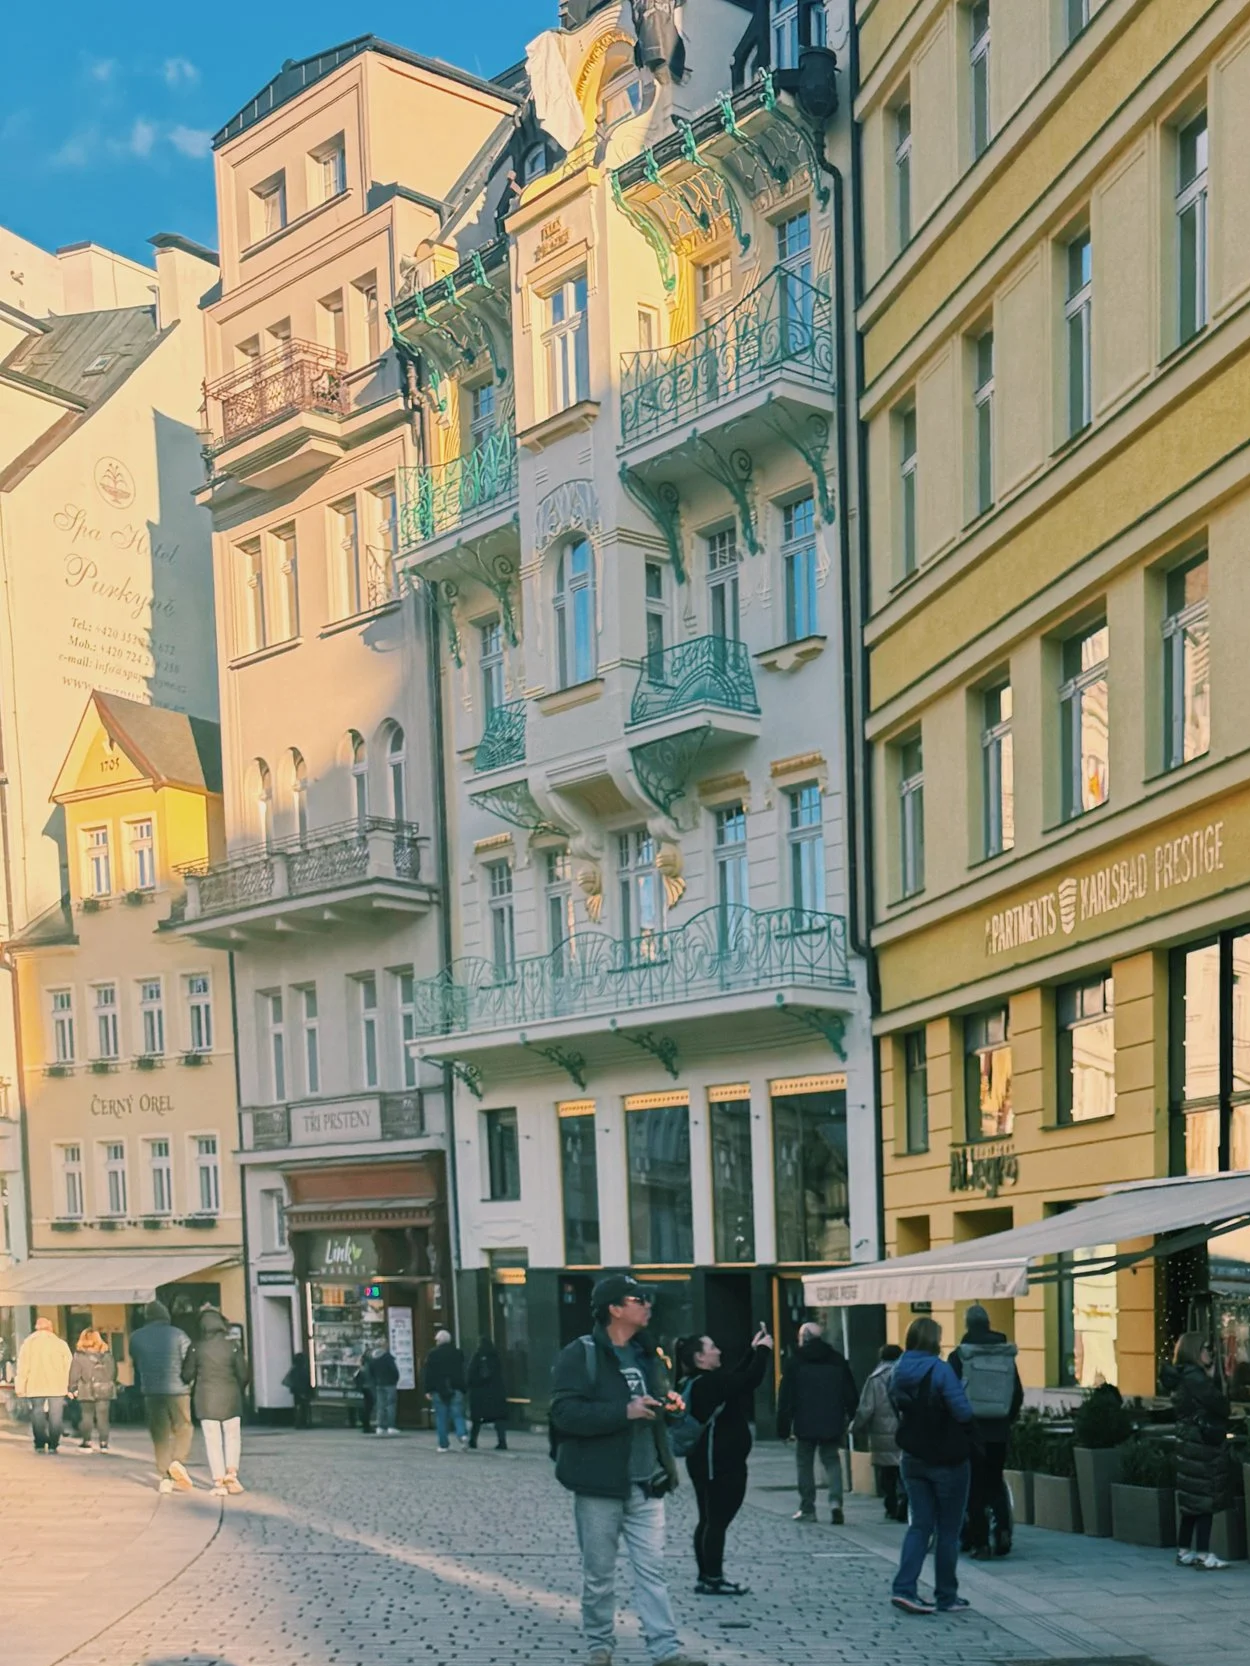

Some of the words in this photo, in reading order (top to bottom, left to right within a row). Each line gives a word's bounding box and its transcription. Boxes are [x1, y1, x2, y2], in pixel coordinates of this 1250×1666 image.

[53, 503, 102, 543] Spa
[100, 757, 119, 772] 1705
[985, 892, 1057, 956] APARTMENTS
[1080, 853, 1148, 921] KARLSBAD
[1155, 821, 1224, 892] PRESTIGE
[90, 1093, 134, 1120] ČERNÝ
[139, 1093, 176, 1118] OREL
[325, 1235, 353, 1265] Link
